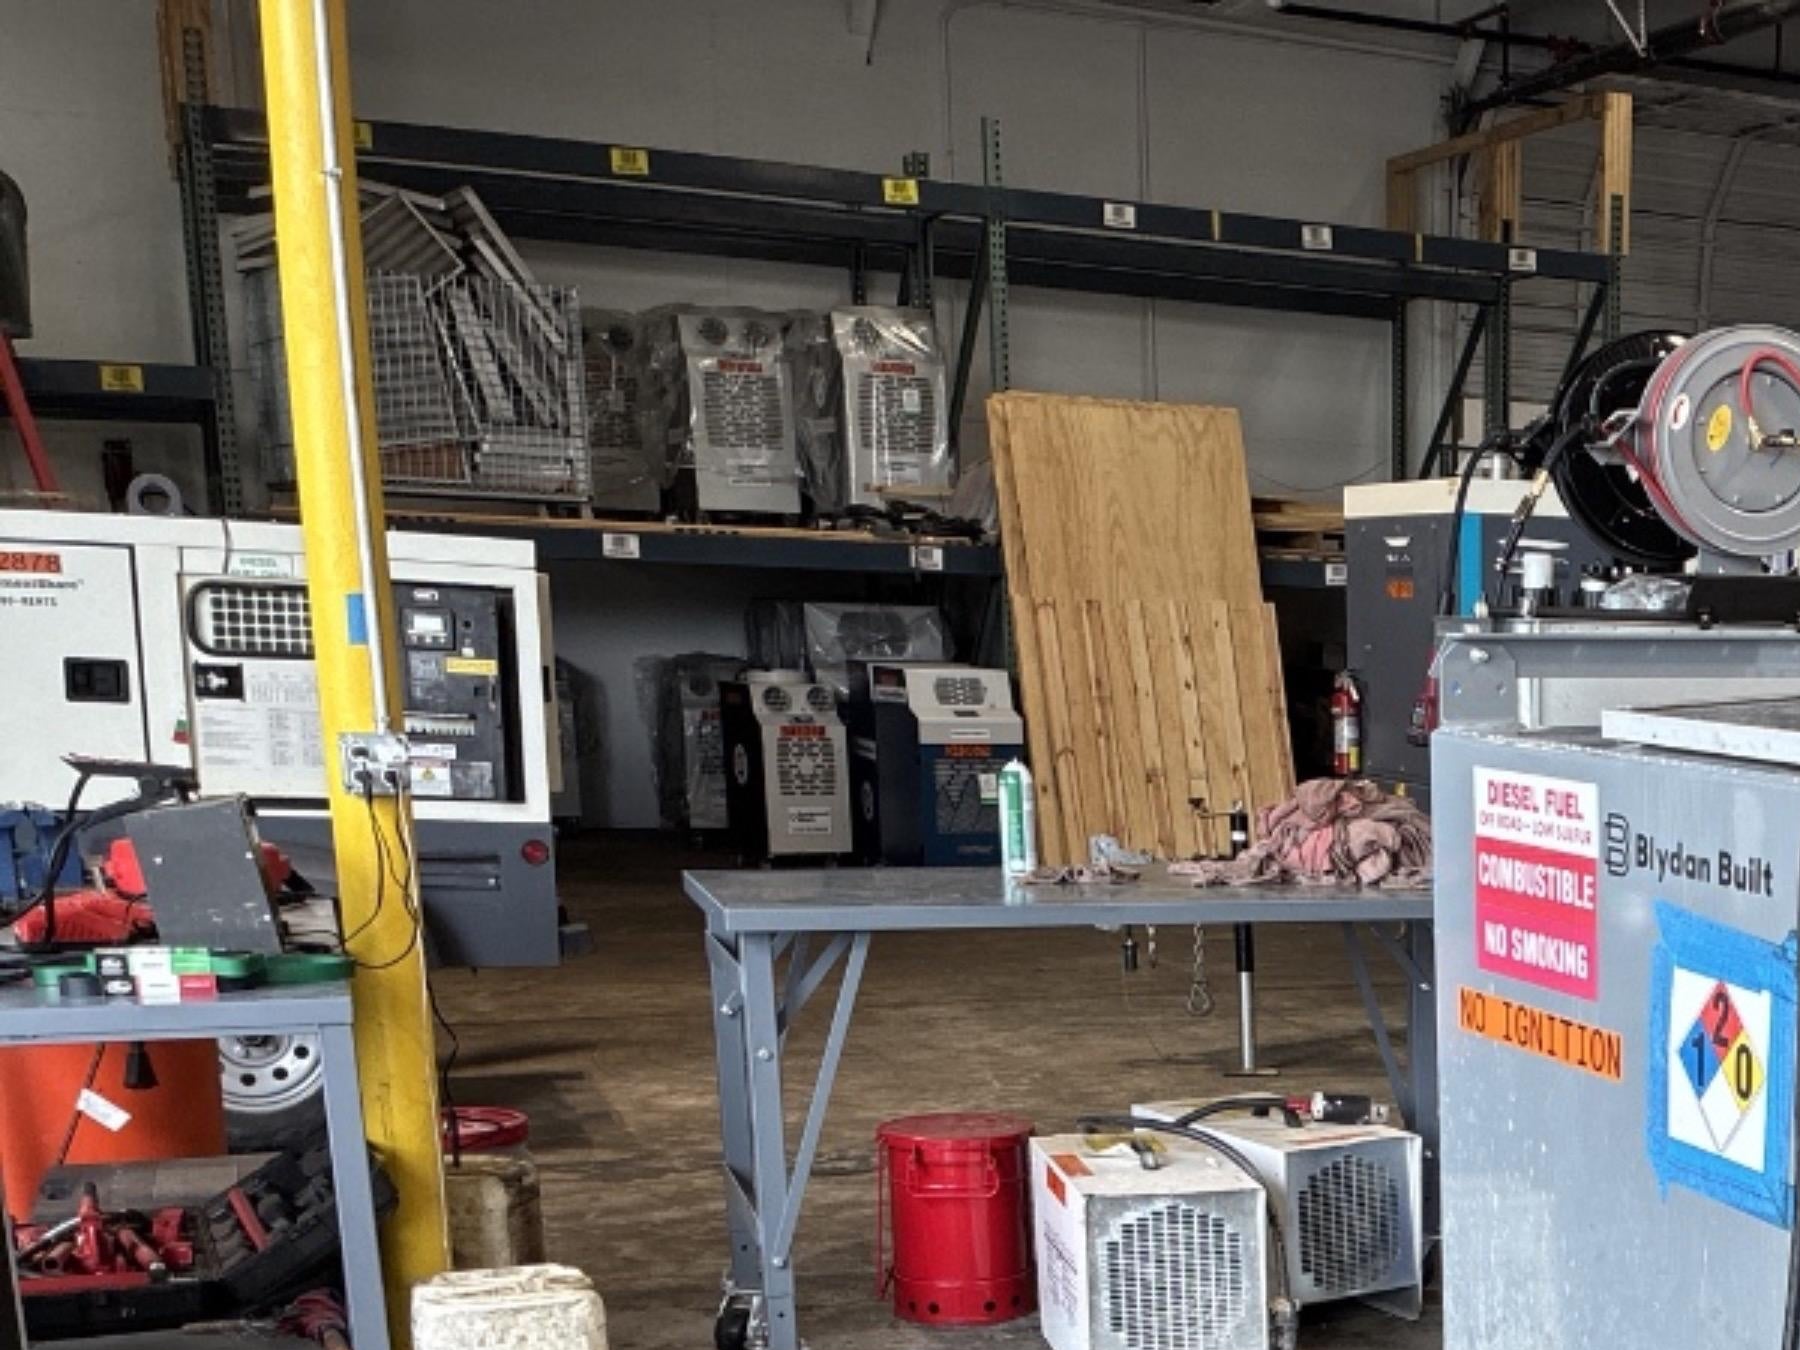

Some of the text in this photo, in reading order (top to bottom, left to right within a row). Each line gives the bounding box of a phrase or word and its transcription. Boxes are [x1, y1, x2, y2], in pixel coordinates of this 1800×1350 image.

[1487, 779, 1585, 821] DIESEL FUEL
[1478, 852, 1595, 910] COMBUSTIBLE
[1634, 832, 1774, 897] Blydan Built
[1483, 921, 1589, 980] NO SMOKING
[1460, 987, 1622, 1079] NO IGNITION
[1712, 992, 1729, 1048] 2
[1692, 1031, 1705, 1087] 1
[1736, 1043, 1754, 1101] 0
